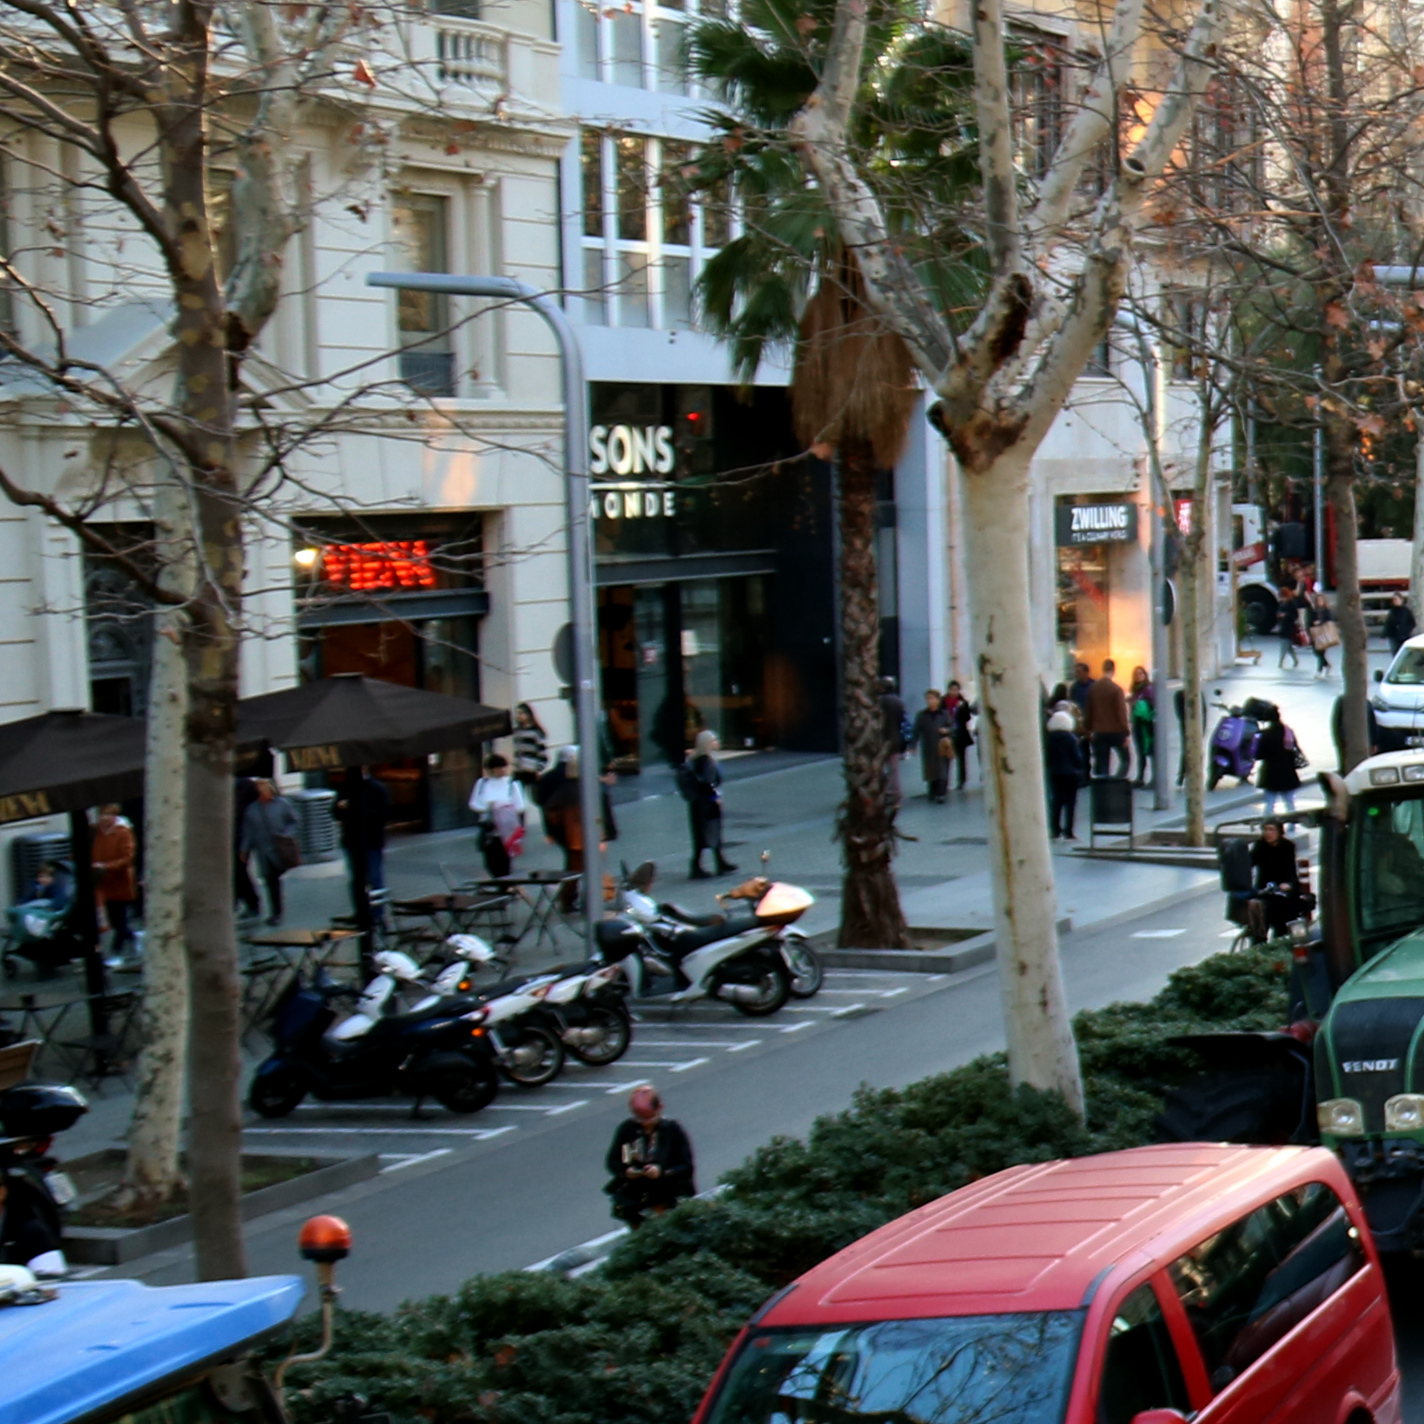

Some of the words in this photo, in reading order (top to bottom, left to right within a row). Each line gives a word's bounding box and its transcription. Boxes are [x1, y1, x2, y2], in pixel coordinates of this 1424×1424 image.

[589, 424, 675, 475] SONS
[1071, 505, 1129, 531] ZWILLING
[1342, 1058, 1399, 1073] FENDT
